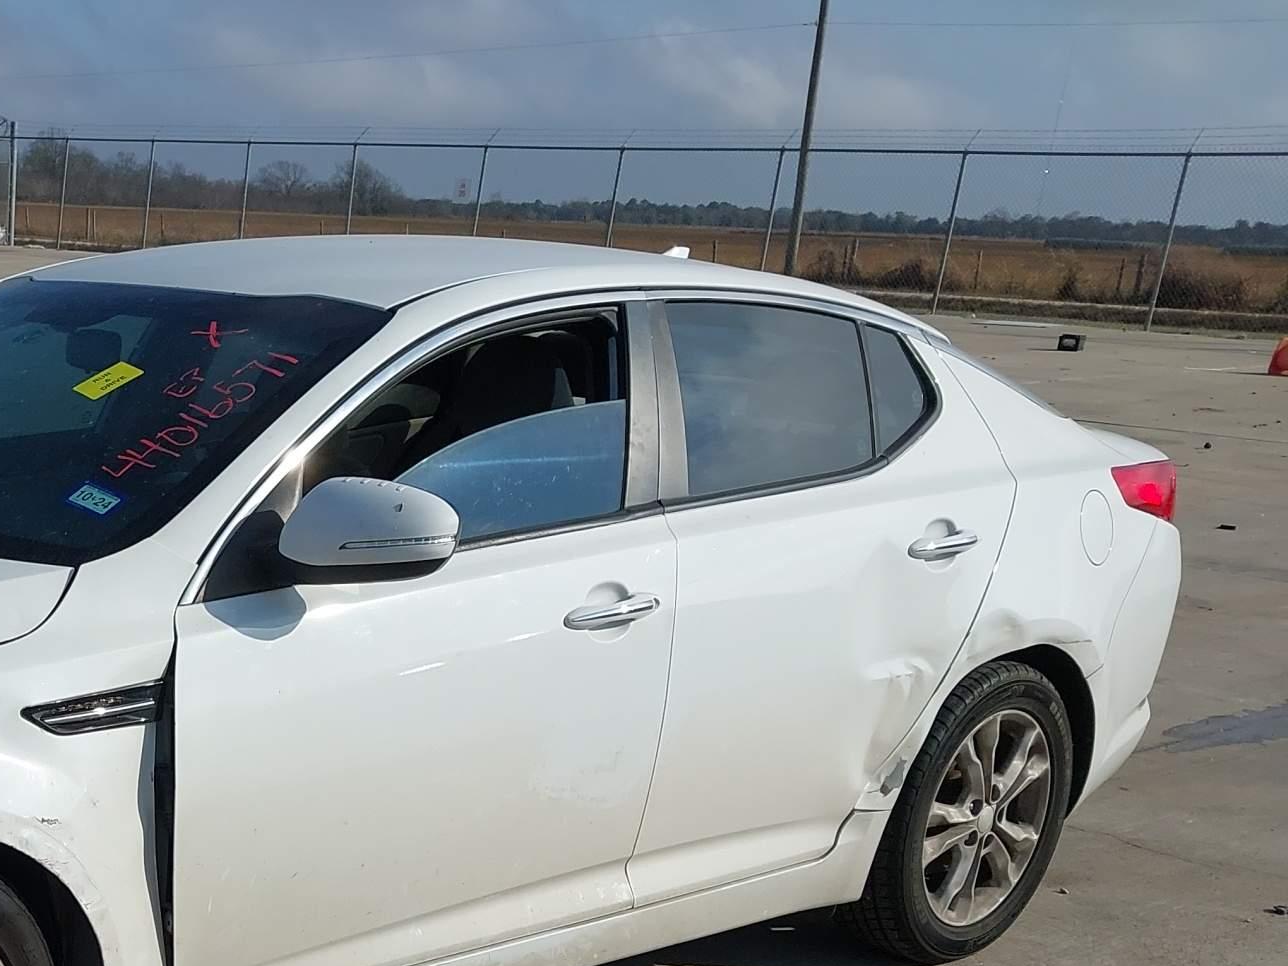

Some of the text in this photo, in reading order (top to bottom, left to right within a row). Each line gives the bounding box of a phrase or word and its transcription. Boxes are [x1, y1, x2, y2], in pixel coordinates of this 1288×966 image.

[99, 375, 127, 391] DRIVE
[101, 351, 299, 478] 44016571
[76, 490, 113, 509] 10 24
